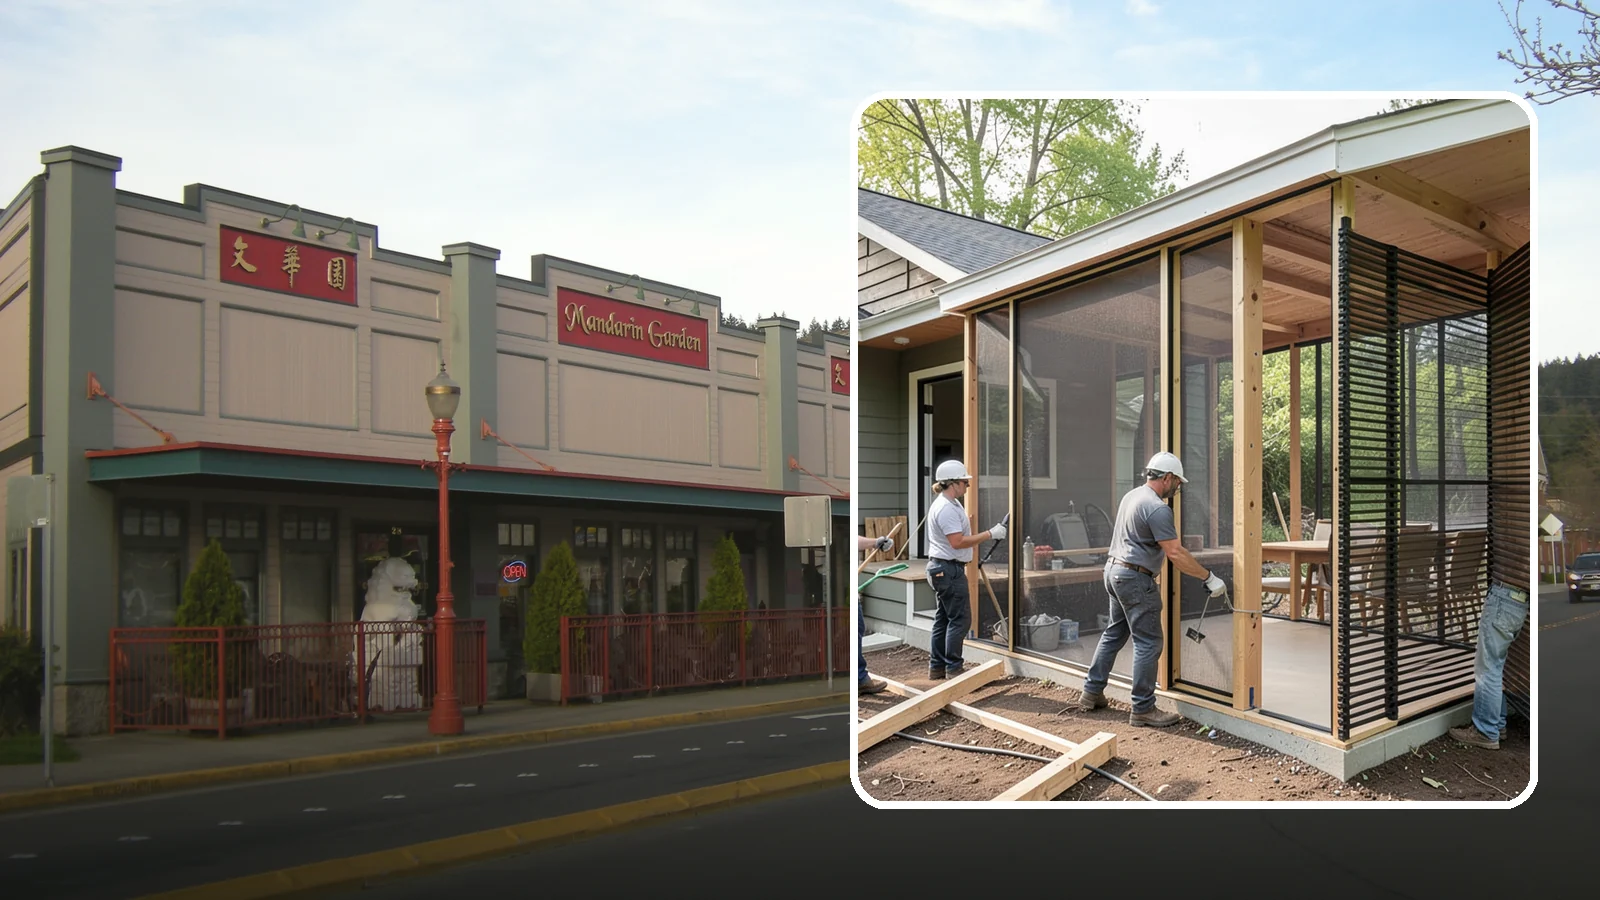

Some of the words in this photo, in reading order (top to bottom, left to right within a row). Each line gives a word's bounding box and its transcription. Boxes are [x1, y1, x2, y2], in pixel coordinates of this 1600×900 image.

[564, 302, 644, 341] Mandarin
[648, 320, 701, 352] Garden
[502, 565, 527, 578] OPEN
